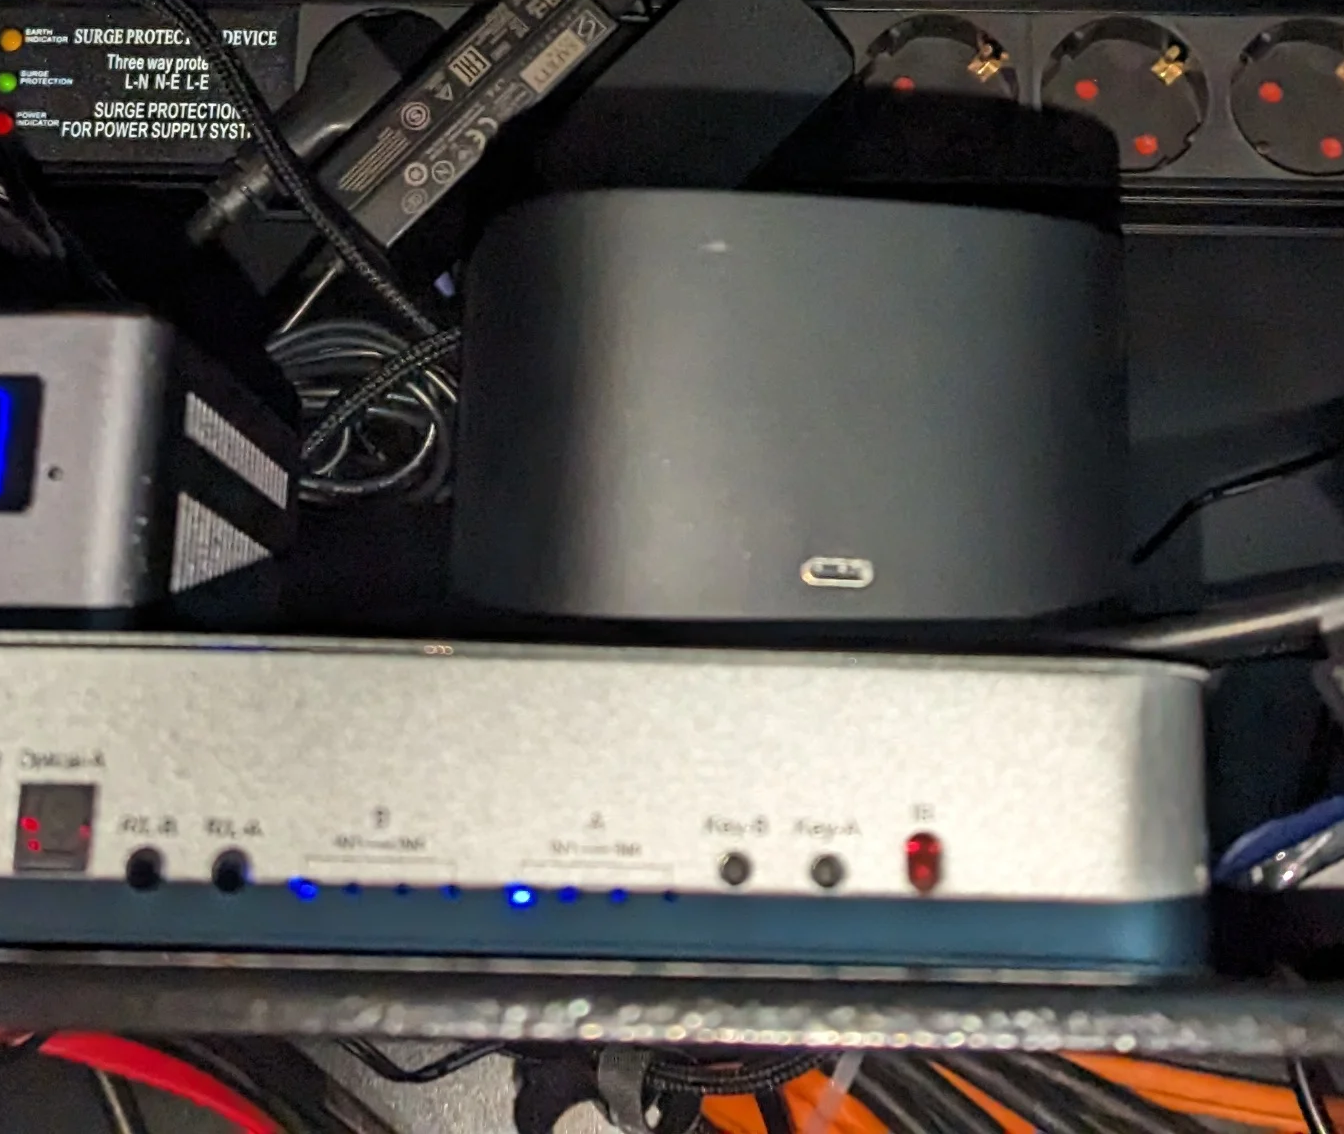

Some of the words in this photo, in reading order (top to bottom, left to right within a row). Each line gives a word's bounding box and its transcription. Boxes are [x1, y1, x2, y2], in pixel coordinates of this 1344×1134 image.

[25, 28, 53, 36] EARTH
[74, 28, 124, 45] SURGE
[126, 28, 191, 45] PROTEC
[222, 29, 277, 46] DEVICE
[107, 53, 144, 70] Three
[147, 57, 174, 74] way
[176, 55, 209, 74] prote
[20, 70, 50, 78] SURGE
[125, 74, 149, 90] L-N
[156, 74, 181, 90] N-E
[187, 74, 210, 90] L-E
[17, 111, 48, 119] POWER
[94, 101, 144, 119] SURGE
[61, 121, 92, 138] FOR
[95, 122, 148, 138] POWER
[151, 123, 208, 139] SUPPLY
[209, 122, 251, 139] SYST
